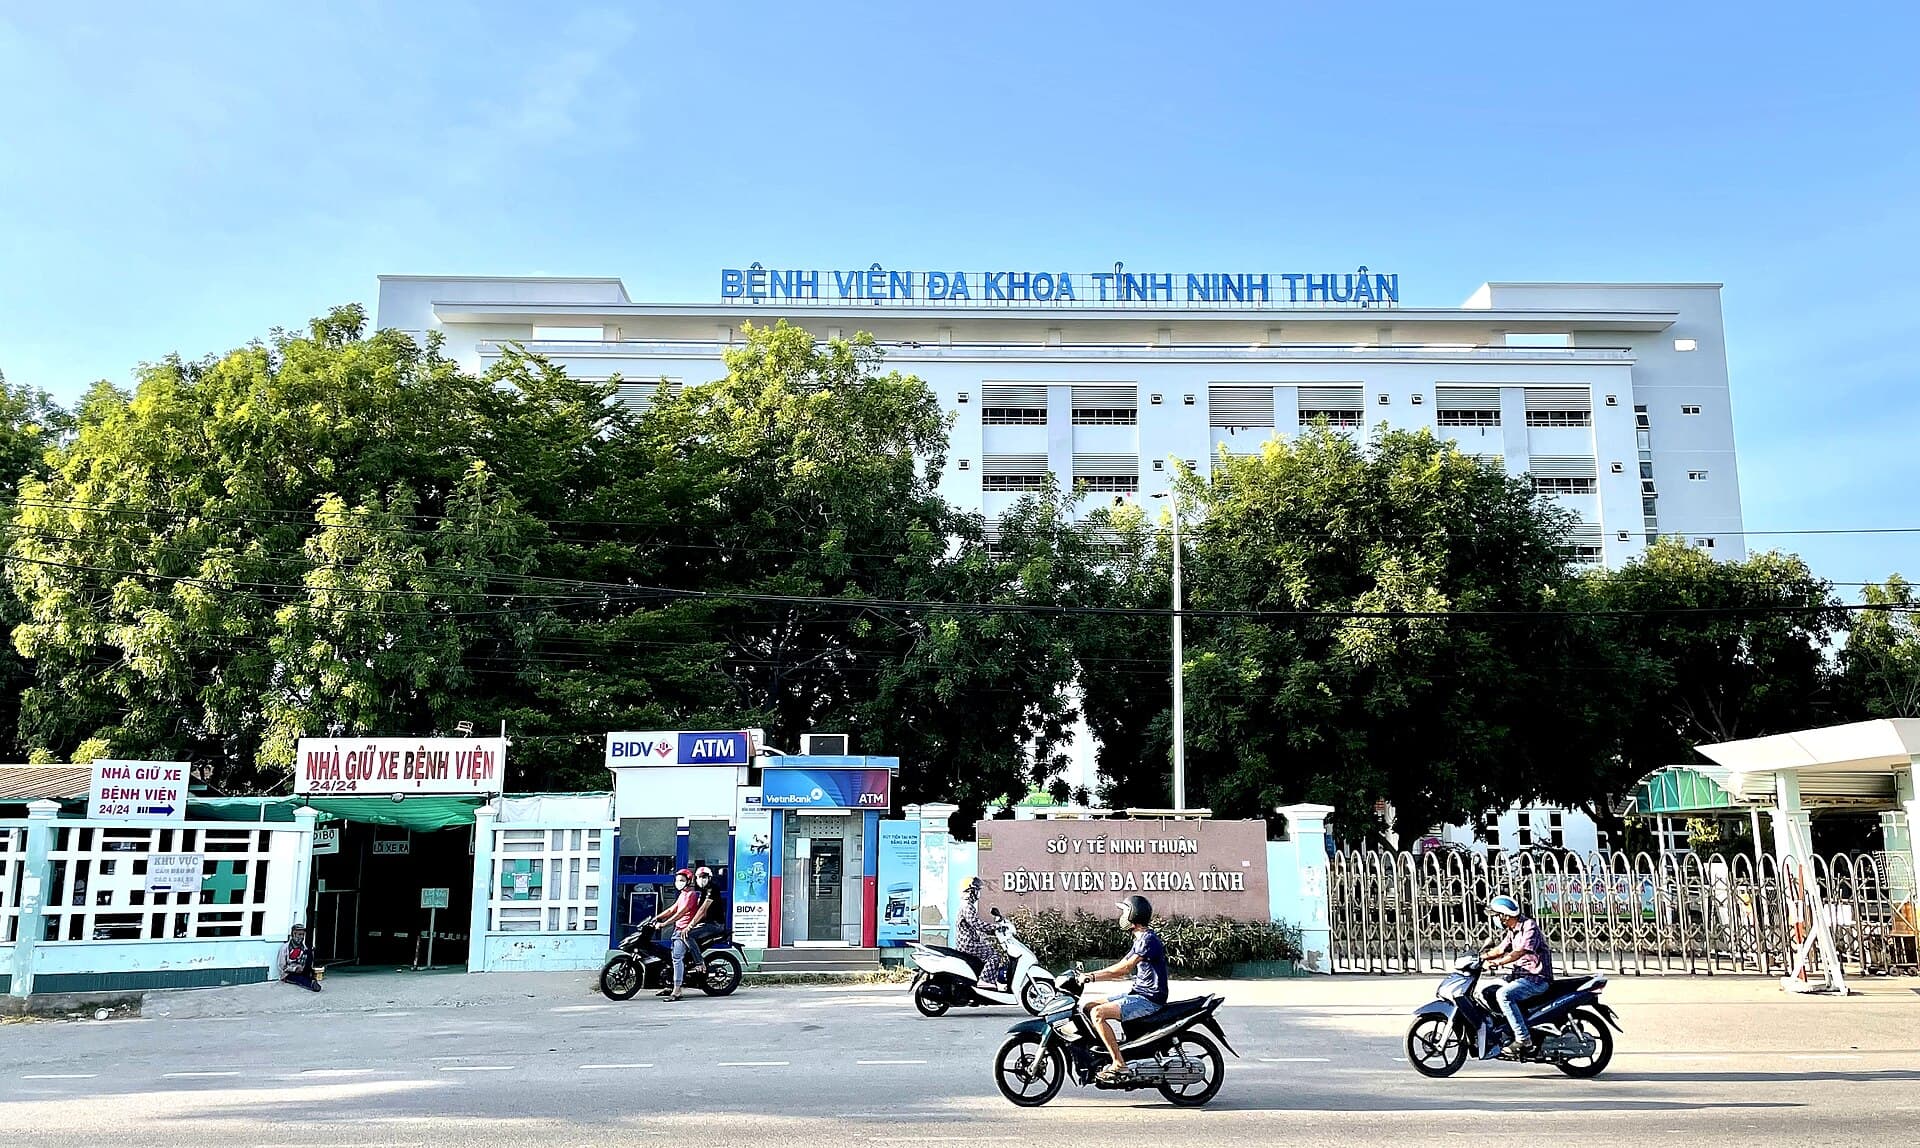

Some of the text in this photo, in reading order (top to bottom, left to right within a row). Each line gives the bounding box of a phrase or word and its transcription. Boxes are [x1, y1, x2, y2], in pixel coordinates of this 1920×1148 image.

[721, 261, 1398, 308] BỆNH VIỆN ĐA KHOA TỈNH NINH THUẬN
[611, 739, 734, 758] BIDV ATM
[101, 765, 182, 780] NHÀ GIỮ XE
[306, 744, 494, 787] NHÀ GIỮ XE BỆNH VIỆN
[101, 785, 177, 804] BỆNH VIỆN
[309, 781, 357, 791] 24/24
[858, 793, 884, 804] ATM
[98, 804, 130, 815] 24/24
[1047, 834, 1198, 856] SỞ Y TẾ NINH THUẬN
[1002, 864, 1245, 895] BỆNH VIỆN ĐA KHOA TỈNH
[736, 905, 756, 913] BIDV
